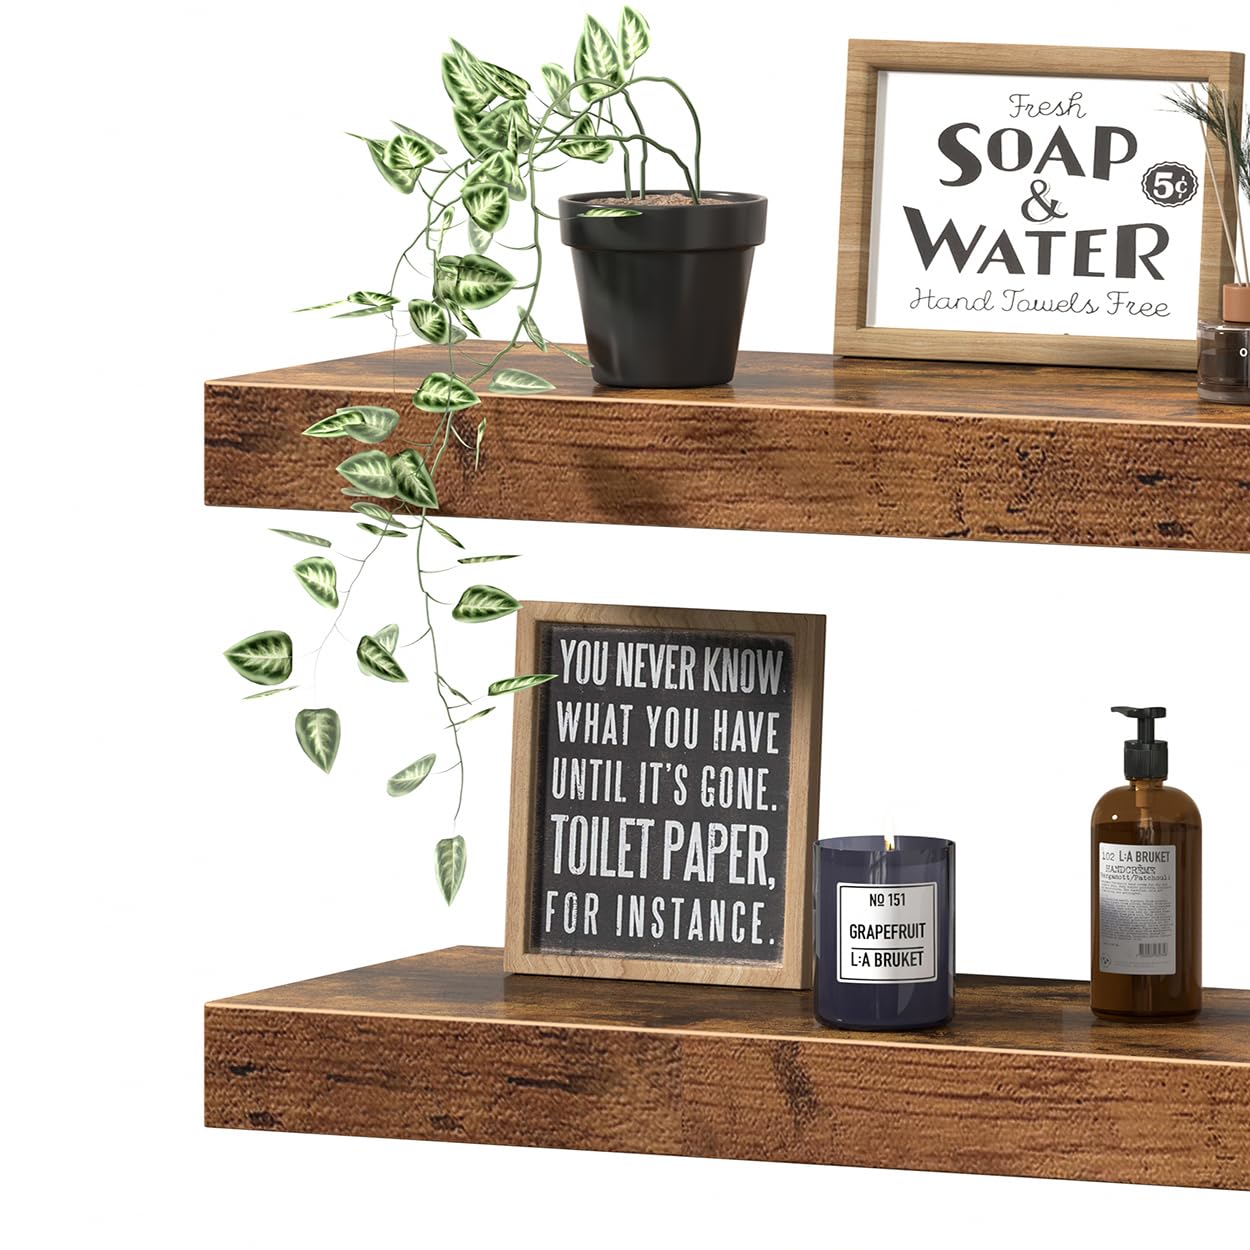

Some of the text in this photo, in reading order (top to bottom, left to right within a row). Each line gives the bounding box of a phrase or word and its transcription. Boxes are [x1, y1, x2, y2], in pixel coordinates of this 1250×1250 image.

[1009, 92, 1087, 118] Fresh
[937, 122, 1138, 187] SOAP
[1021, 179, 1068, 223] &
[903, 205, 1170, 280] WATER
[909, 287, 1170, 317] Hand Towels Free
[561, 639, 783, 695] YOU NEVER KNOW
[557, 701, 780, 755] WHAT YOU HAVE
[552, 757, 778, 811] UNTIL IT'S GONE.
[551, 815, 776, 890] TOILET PAPER,
[1119, 850, 1133, 862] L:A
[1135, 850, 1170, 863] BRUKET
[545, 890, 775, 945] FOR INSTANCE.
[888, 893, 905, 906] 151
[849, 922, 926, 940] GRAPEFRUIT
[851, 951, 924, 967] L:A BRUKET
